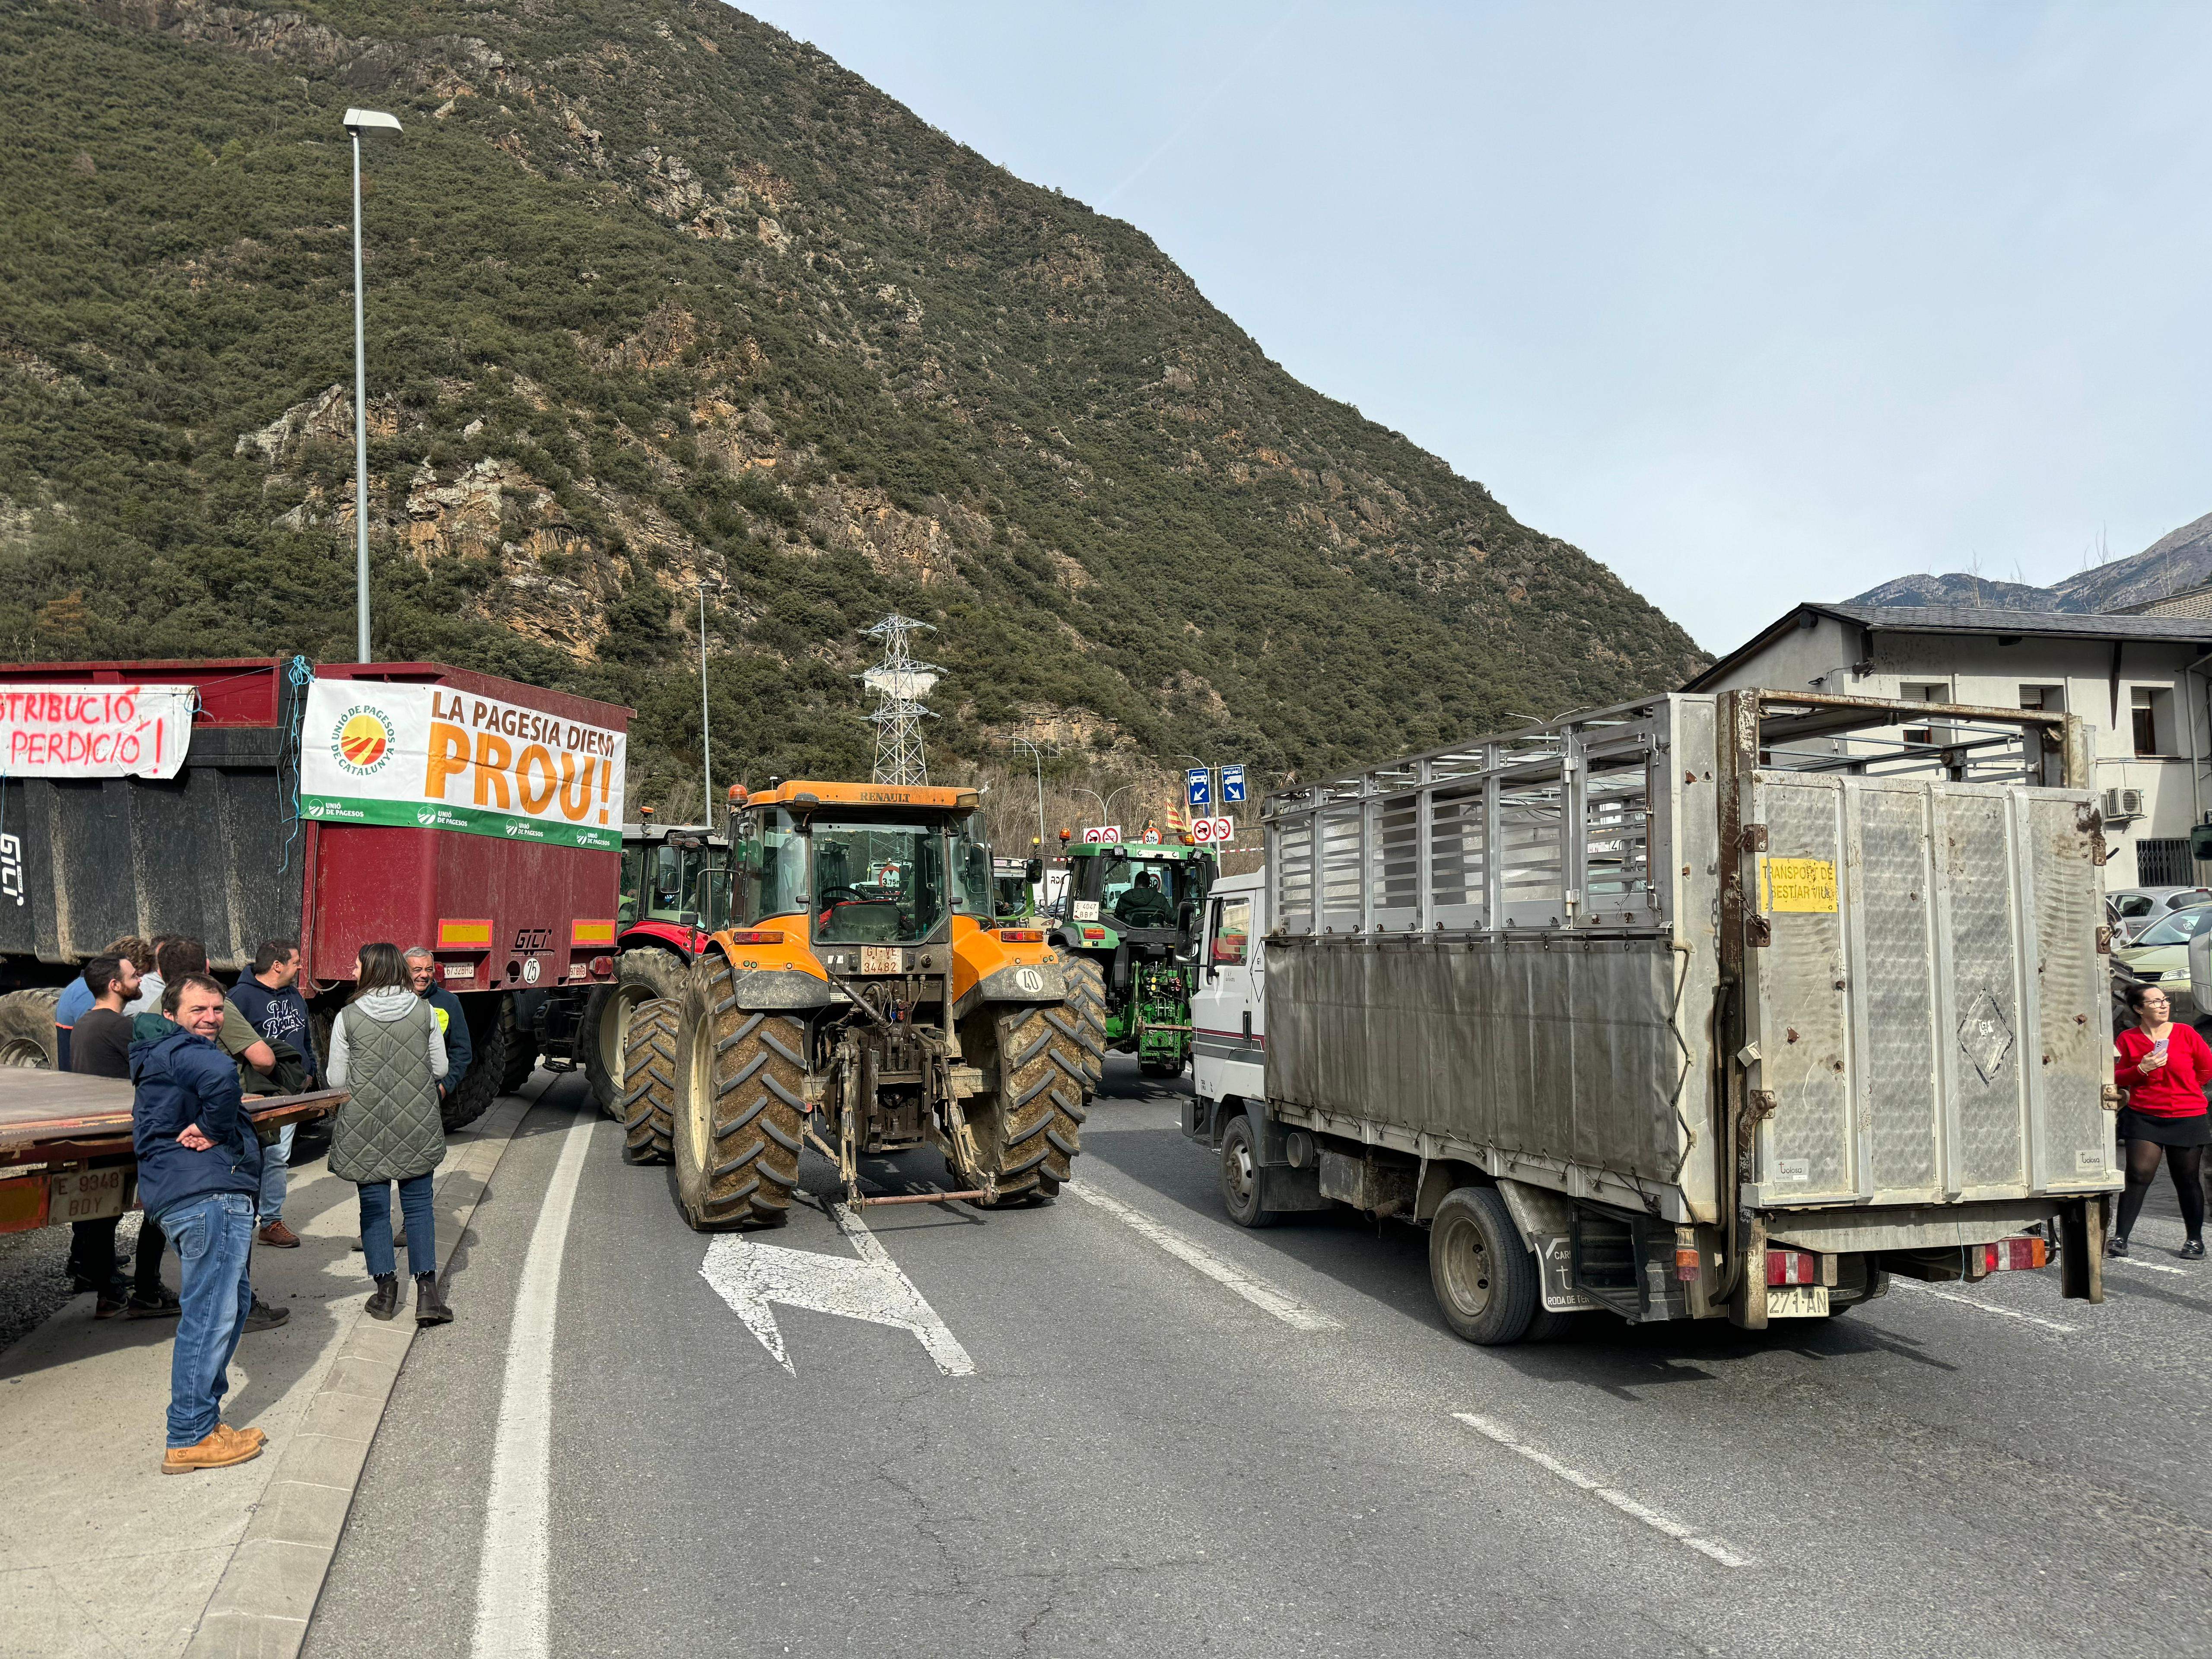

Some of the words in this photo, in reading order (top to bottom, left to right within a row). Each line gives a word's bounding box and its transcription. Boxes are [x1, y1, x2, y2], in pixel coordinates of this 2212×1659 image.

[331, 713, 348, 740] UNIÓ
[348, 705, 361, 716] DE
[364, 705, 395, 743] PAGESOS
[432, 691, 464, 724] LA
[472, 701, 561, 747] PAGESIA
[567, 725, 614, 757] DIEM
[331, 744, 342, 760] DE
[339, 748, 394, 776] CATALUNYA
[425, 721, 612, 825] PROU!
[860, 792, 910, 802] RENAULT
[446, 818, 468, 827] PAGESOS
[1821, 867, 1833, 880] DE
[527, 960, 537, 981] 25
[864, 962, 896, 972] 34482
[1022, 971, 1039, 990] 40
[1778, 1161, 1802, 1174] tolosa
[59, 1178, 68, 1195] E
[79, 1172, 119, 1192] 9348
[1554, 1250, 1571, 1260] CAR
[1548, 1297, 1566, 1306] RODA
[1567, 1296, 1576, 1304] DE
